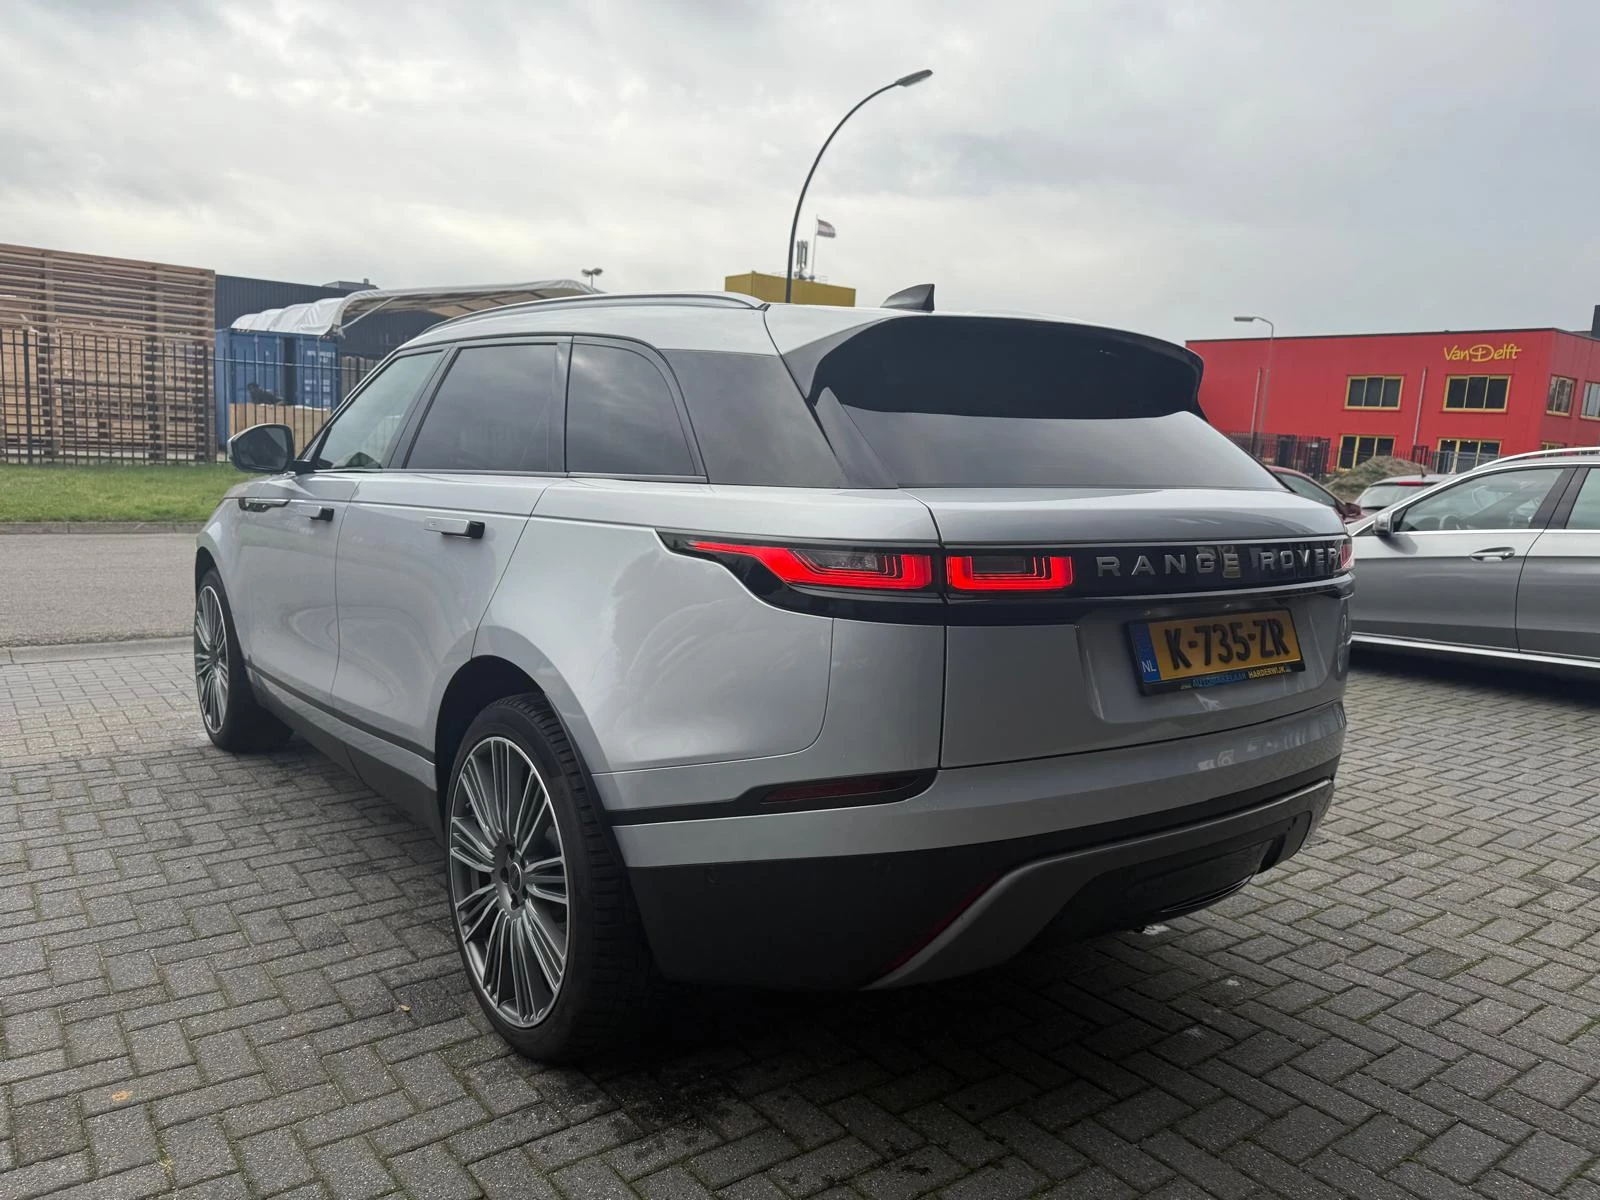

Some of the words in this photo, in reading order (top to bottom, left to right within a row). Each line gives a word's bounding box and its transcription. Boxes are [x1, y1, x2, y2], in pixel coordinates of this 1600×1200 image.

[1095, 552, 1241, 578] RANGE
[1259, 547, 1339, 571] ROVER
[1164, 617, 1291, 670] K-735-ZR
[1141, 659, 1157, 674] NL
